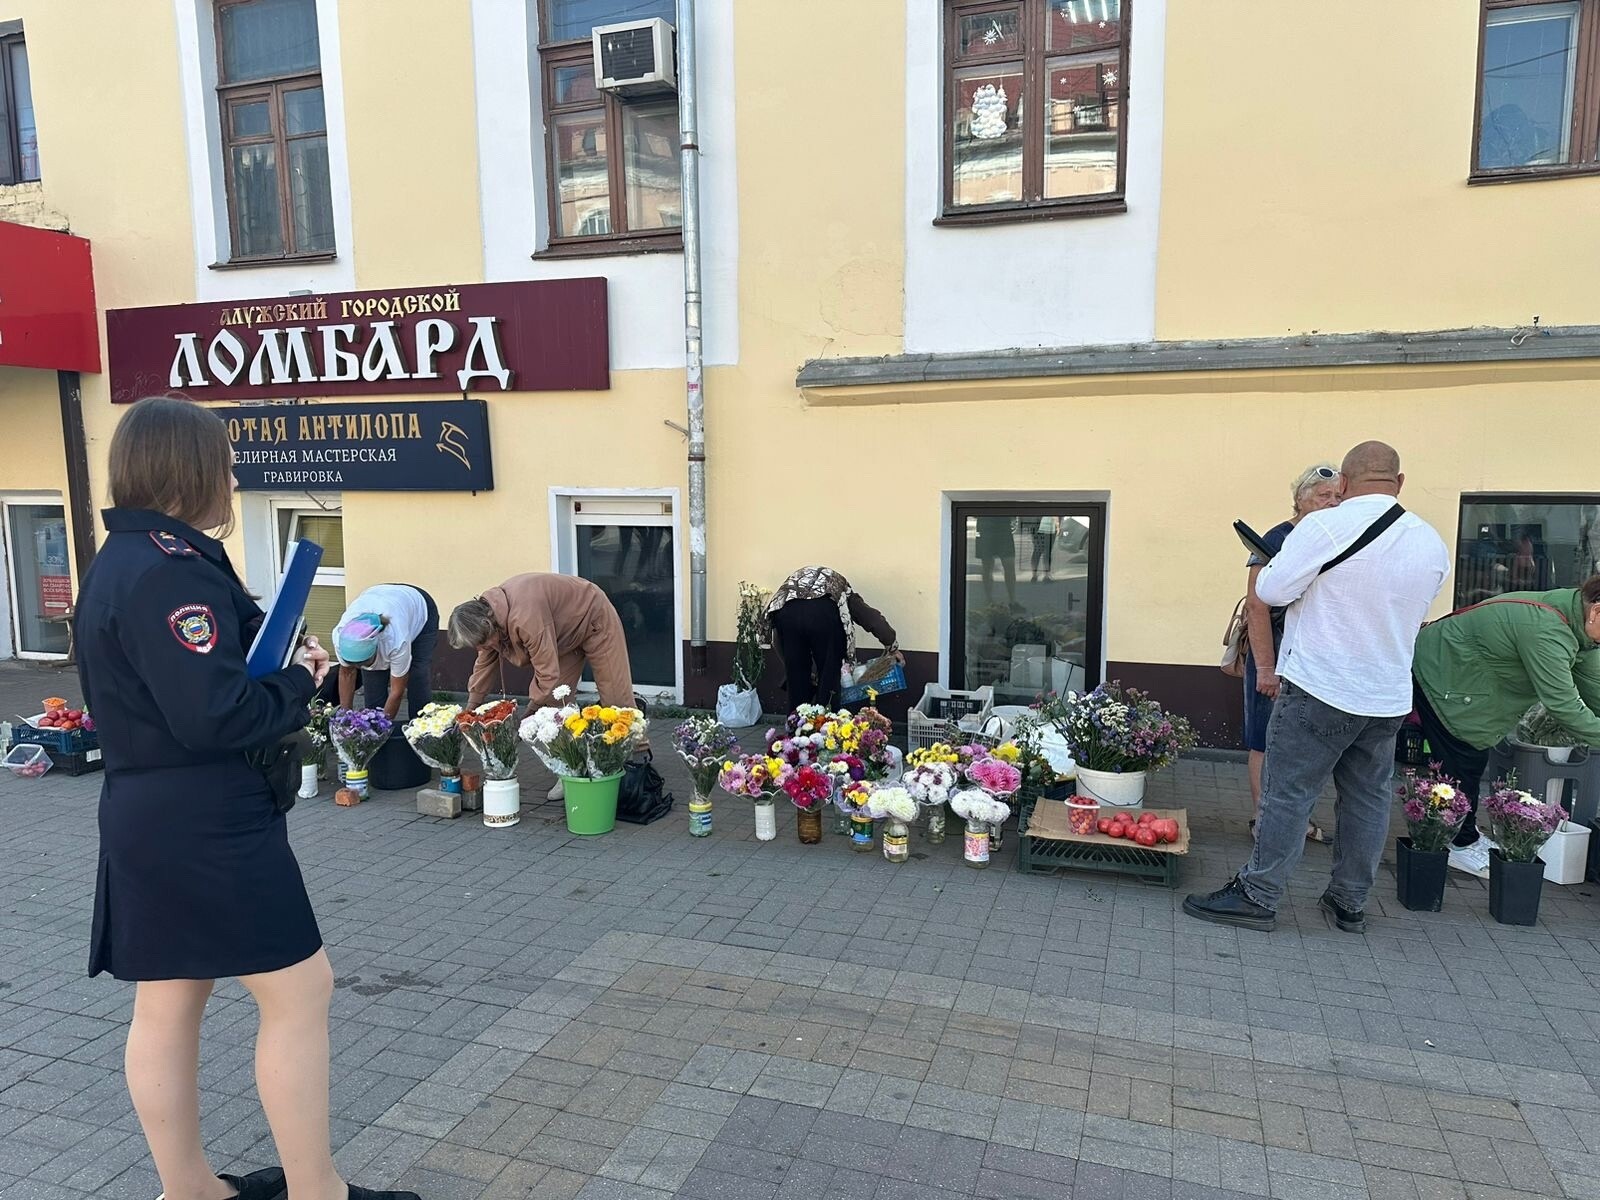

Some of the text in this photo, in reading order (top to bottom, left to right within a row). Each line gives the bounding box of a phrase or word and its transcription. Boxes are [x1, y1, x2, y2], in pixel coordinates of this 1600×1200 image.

[341, 288, 461, 319] ГОРОДСКОЙ
[169, 316, 511, 391] ЛОМБАРД
[228, 412, 422, 446] ОТАЯ АНТИЛОПА
[234, 448, 397, 464] ЕЛИРНАЯ МАСТЕРСКАЯ
[263, 470, 344, 483] ГРАВИРОВКА
[170, 605, 208, 622] ПОЛИЦИЯ
